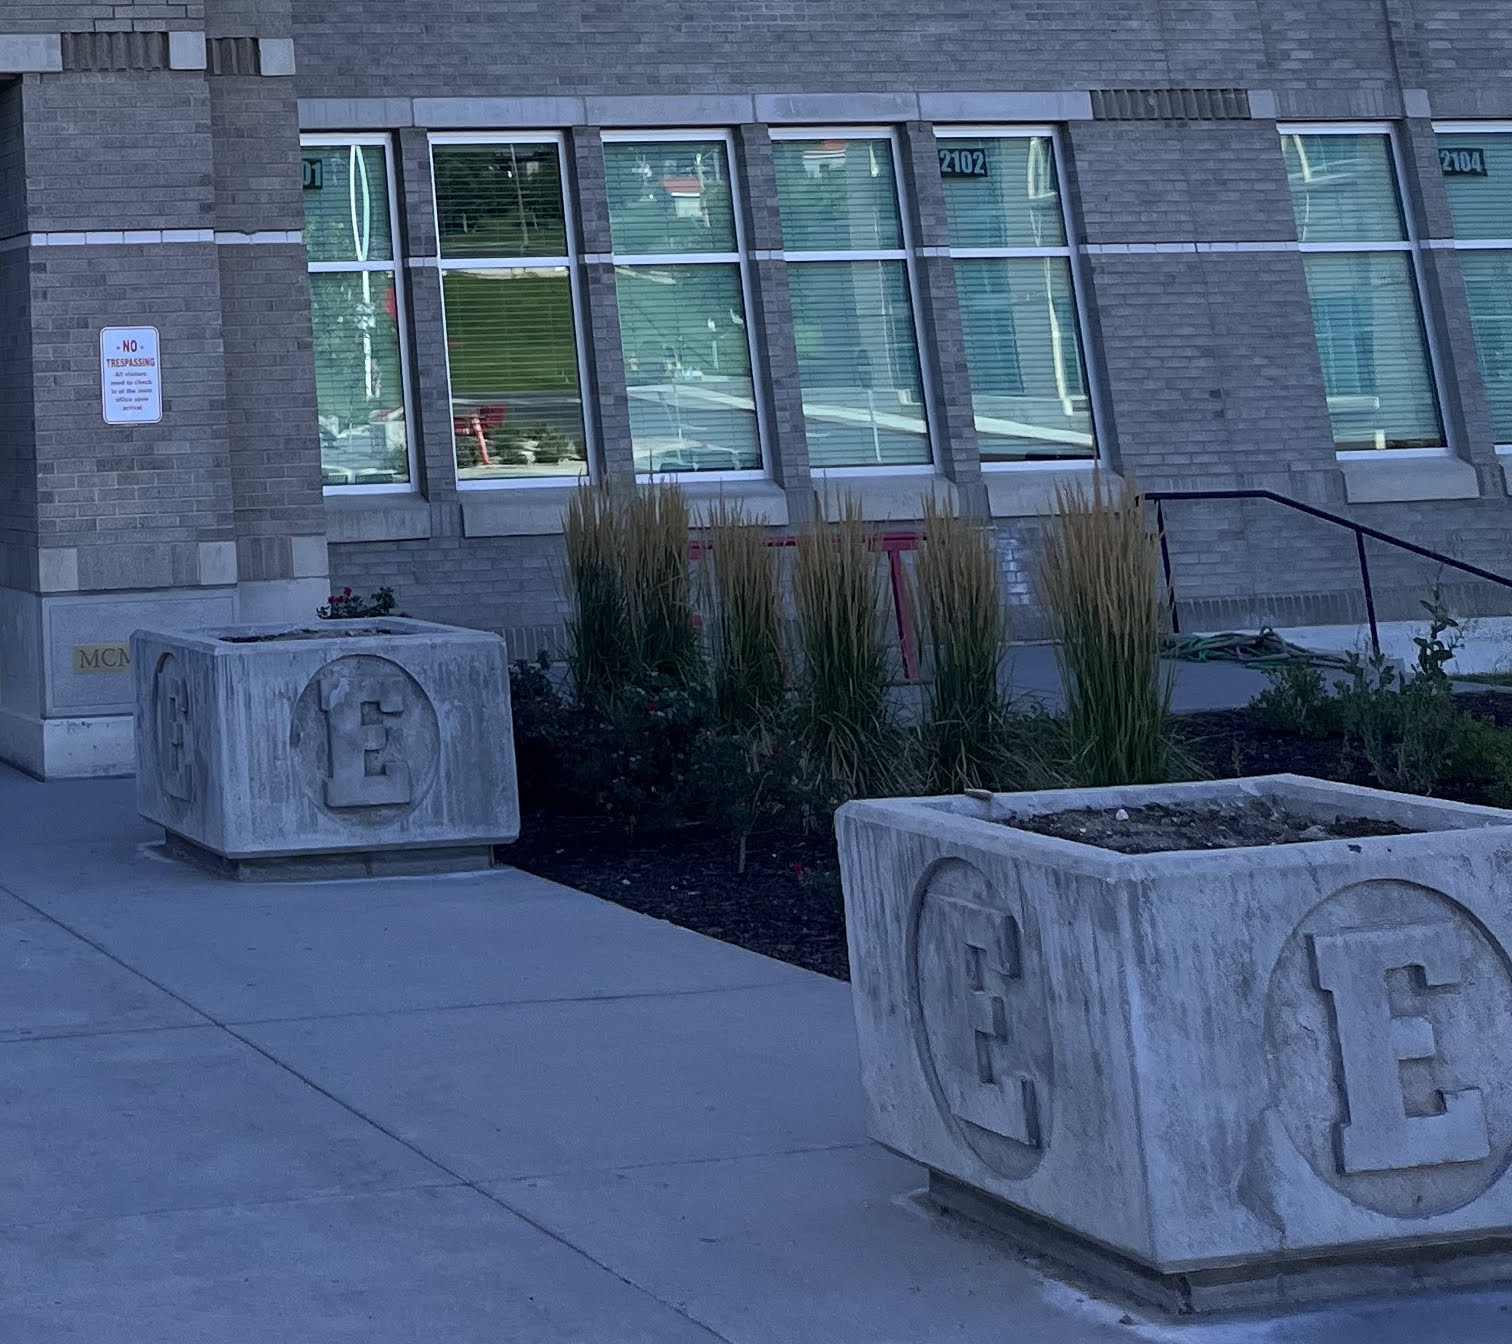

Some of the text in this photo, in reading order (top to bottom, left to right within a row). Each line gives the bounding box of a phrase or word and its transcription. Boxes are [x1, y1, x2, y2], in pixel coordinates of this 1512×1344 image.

[302, 160, 321, 186] 01
[940, 149, 985, 174] 2102
[1440, 150, 1483, 173] 2104
[122, 339, 138, 352] NO
[106, 358, 155, 368] TRESPASSING
[318, 673, 411, 808] E
[1303, 920, 1491, 1175] E
